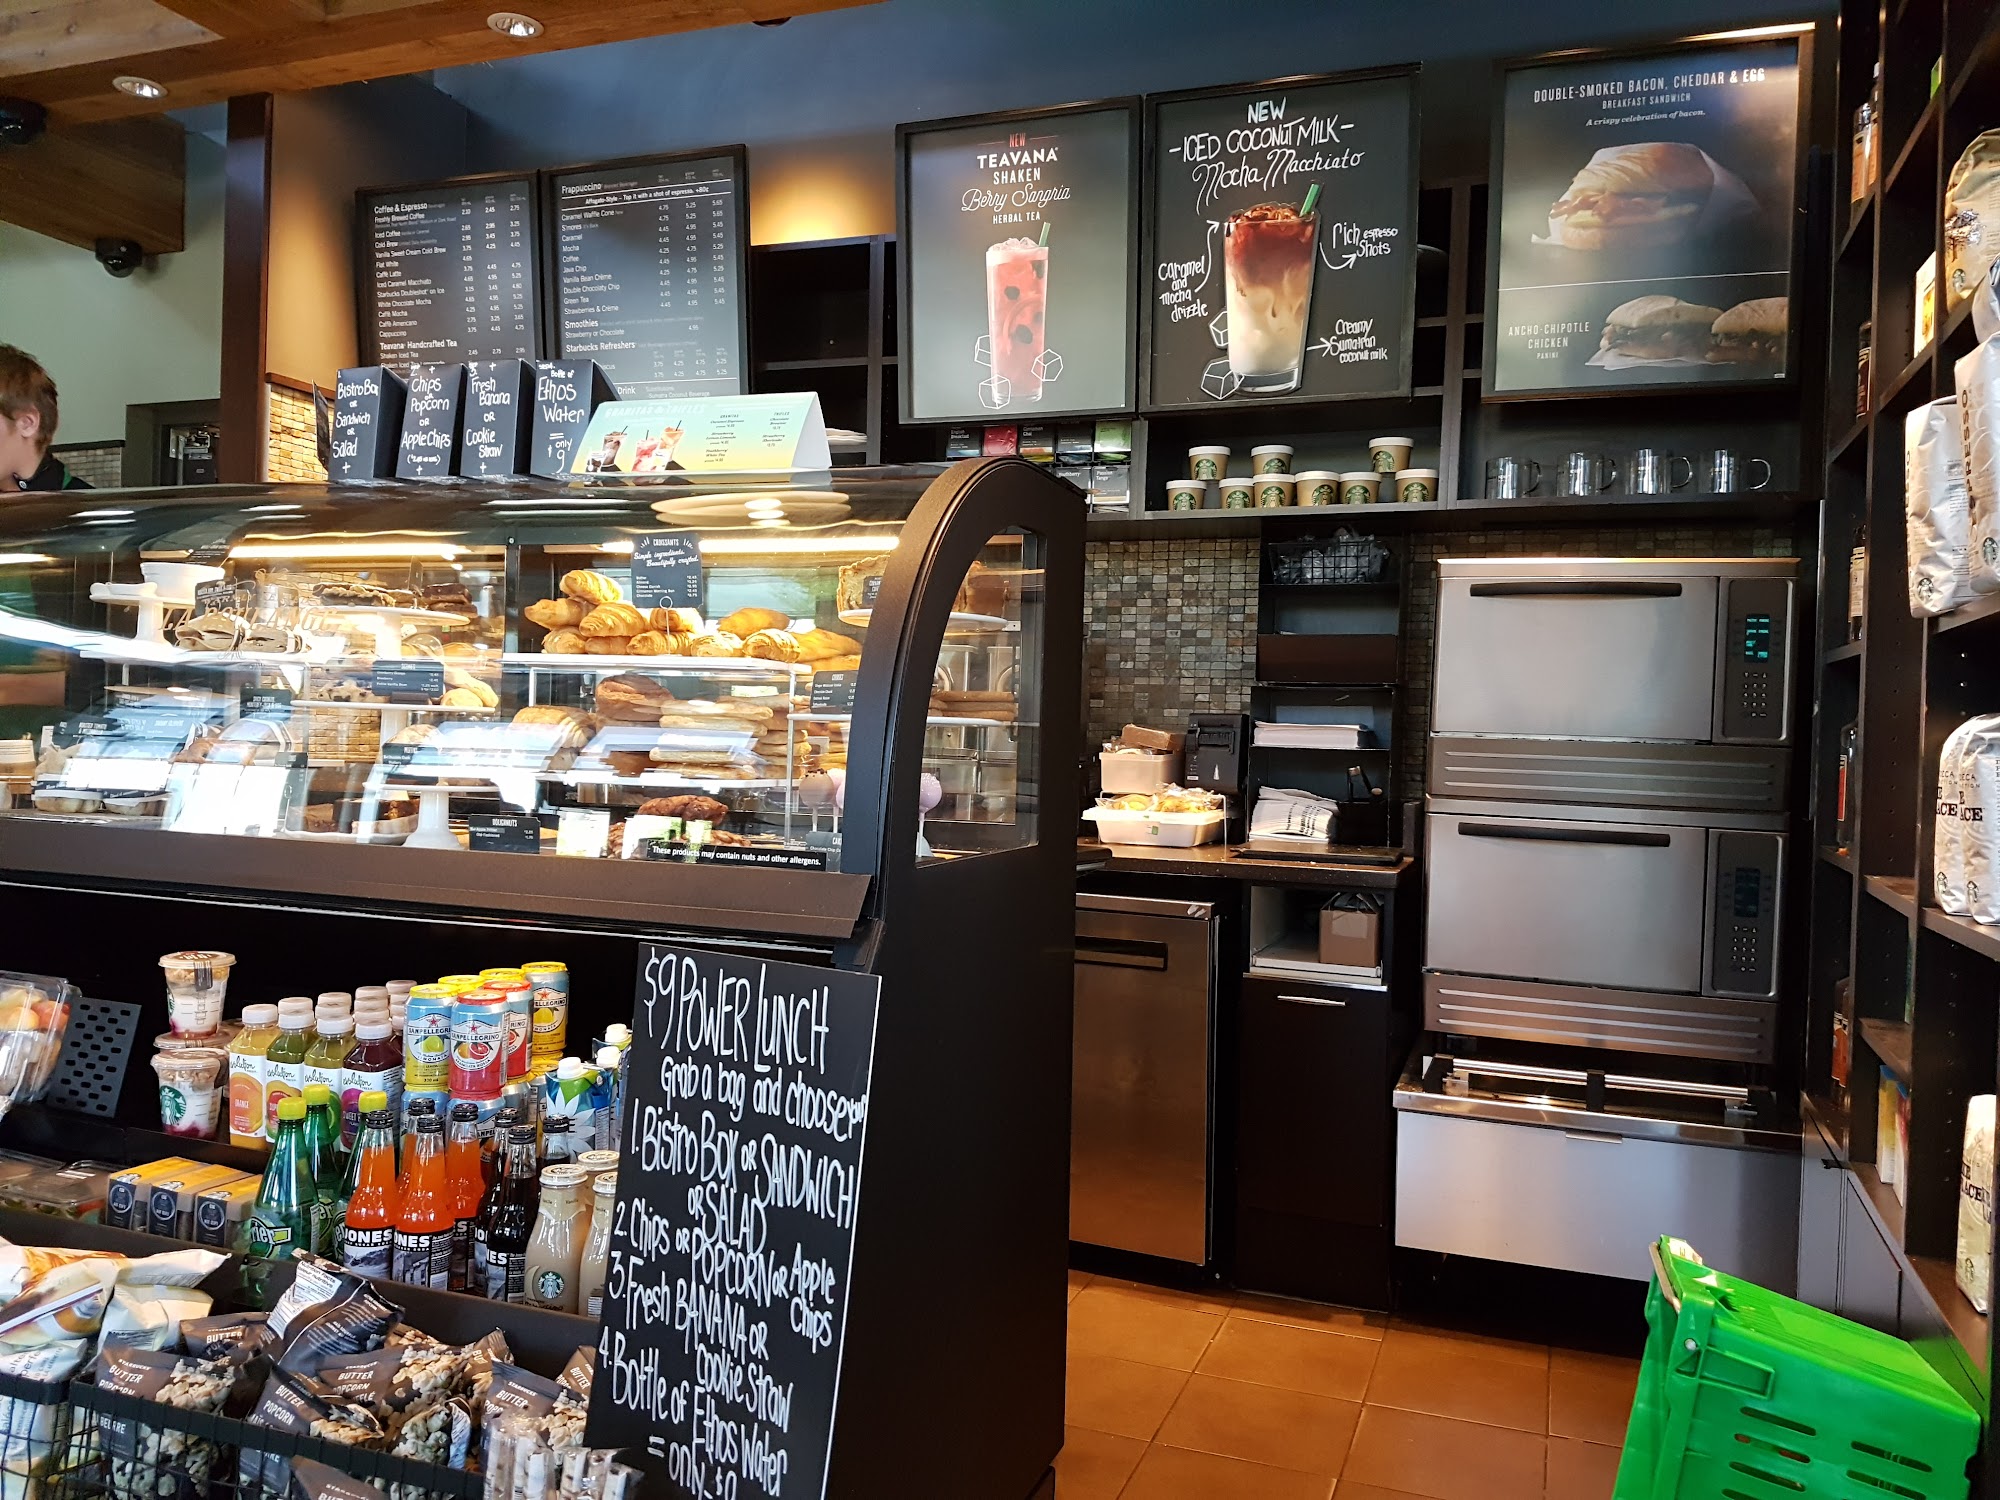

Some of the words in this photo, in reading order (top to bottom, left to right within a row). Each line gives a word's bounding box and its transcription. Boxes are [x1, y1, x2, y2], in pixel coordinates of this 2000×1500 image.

[1534, 81, 1623, 103] DOUBLE-SMOKED
[1674, 71, 1725, 89] CHEDDAR
[1729, 70, 1738, 83] &
[1742, 68, 1765, 83] EGG
[1247, 97, 1286, 123] NEW
[1602, 97, 1646, 110] BREAKFAST
[1650, 93, 1691, 105] SANDWICH
[1593, 117, 1620, 127] crispy
[1621, 112, 1668, 123] celebration
[1669, 110, 1679, 120] of
[1009, 133, 1026, 148] NEW
[993, 167, 1041, 185] SHAKEN
[1192, 156, 1263, 216] Mocha
[1263, 148, 1366, 192] Macchiato
[961, 188, 1008, 212] Berry
[1012, 183, 1071, 208] Sangria
[374, 205, 394, 214] Coffee
[400, 203, 428, 212] Espresso
[561, 212, 583, 221] Caramel
[583, 211, 600, 219] Waffle
[601, 209, 615, 217] Cone
[993, 213, 1023, 224] HERBAL
[1026, 211, 1041, 221] TEA
[561, 234, 583, 242] Caramel
[1363, 227, 1398, 241] espresso
[1171, 275, 1188, 292] and
[1171, 299, 1208, 323] drizzle
[564, 319, 599, 329] Smoothies
[1335, 318, 1373, 337] Creamy
[1508, 321, 1590, 337] ANCHO-CHIPOTLE
[407, 339, 445, 349] Handcrafted
[446, 338, 458, 347] Tea
[566, 343, 599, 353] Starbucks
[1528, 337, 1569, 349] CHICKEN
[1340, 349, 1370, 364] coconut
[1370, 347, 1388, 361] milk
[1536, 352, 1559, 360] PANINI
[411, 376, 442, 394] Chips
[471, 377, 496, 394] Fresh
[538, 376, 577, 403] Ethos
[618, 386, 636, 395] Drink
[411, 398, 450, 416] Popcorn
[479, 392, 510, 406] Banana
[335, 412, 371, 428] Sandwich
[483, 412, 496, 422] OR
[543, 403, 585, 423] Water
[419, 418, 430, 426] OR
[347, 428, 355, 436] OR
[401, 431, 427, 450] Apple
[427, 429, 451, 449] Chips
[466, 427, 496, 446] Cookie
[332, 437, 358, 458] Salad
[479, 444, 503, 458] Straw
[555, 438, 573, 451] only
[653, 846, 671, 855] These
[672, 847, 700, 857] products
[701, 851, 714, 859] may
[715, 851, 740, 860] contain
[741, 853, 756, 861] nuts
[757, 854, 770, 862] and
[771, 855, 789, 863] other
[789, 856, 821, 866] allergens.
[675, 957, 751, 1062] POWER
[408, 1027, 451, 1036] SANPELLEGRI
[661, 1055, 700, 1111] Grab
[701, 1064, 712, 1100] a
[718, 1062, 746, 1122] bag
[753, 1066, 782, 1116] and
[642, 1105, 699, 1176] Bistro
[741, 1139, 758, 1172] OR
[755, 1133, 855, 1229] SANDWICH
[687, 1186, 704, 1220] OR
[703, 1182, 767, 1256] SALAD
[344, 1228, 393, 1243] JONES
[394, 1234, 430, 1248] ONES
[630, 1197, 670, 1262] Chips
[675, 1228, 690, 1254] OR
[692, 1227, 775, 1308] POPCORN
[771, 1265, 790, 1300] OR
[789, 1242, 835, 1305] Apple
[625, 1257, 670, 1330] Fresh
[674, 1278, 747, 1364] BANANA
[749, 1321, 769, 1360] OR
[790, 1297, 832, 1353] Chips
[109, 1365, 144, 1384] BUTTER
[338, 1371, 374, 1381] BUTTER
[570, 1366, 591, 1390] BUTTER
[275, 1384, 305, 1408] BUTTER
[508, 1381, 538, 1397] STARBUCKS
[696, 1343, 744, 1403] Cookie
[747, 1361, 794, 1433] Straw
[496, 1390, 529, 1409] BUTTER
[263, 1400, 295, 1426] POPCORN
[612, 1331, 668, 1422] Bottle
[670, 1380, 690, 1425] of
[692, 1386, 738, 1465] Ethos
[741, 1422, 788, 1497] Water
